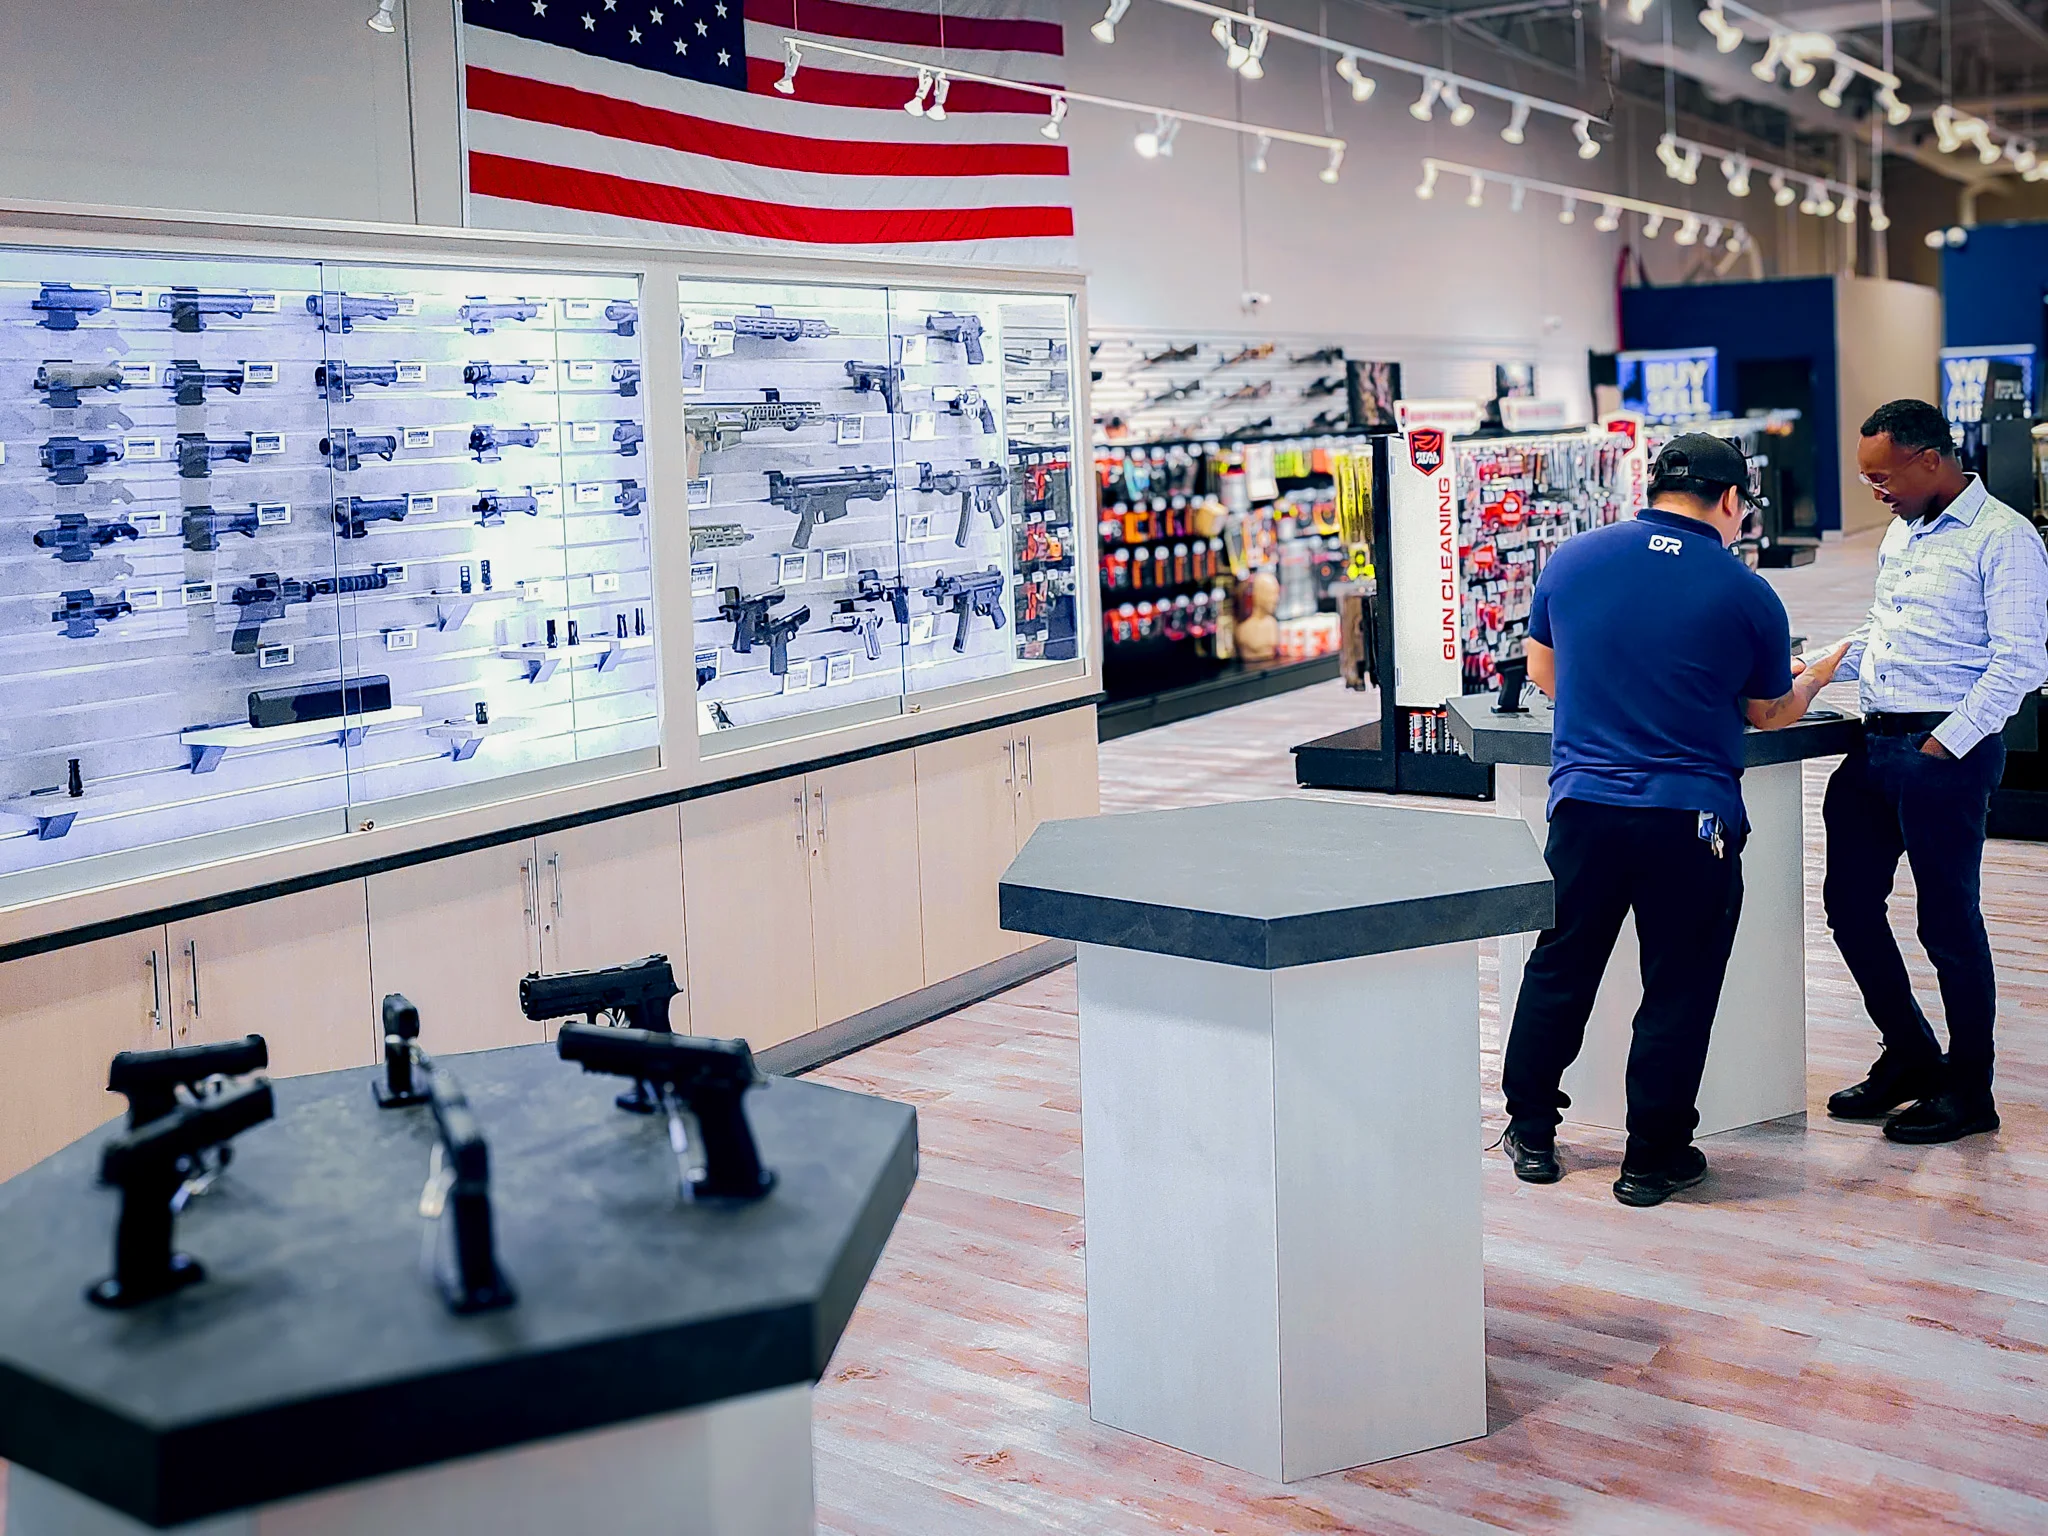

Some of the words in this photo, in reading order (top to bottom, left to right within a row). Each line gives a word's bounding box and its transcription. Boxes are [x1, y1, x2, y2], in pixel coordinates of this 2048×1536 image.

[1646, 361, 1709, 388] BUY
[1647, 388, 1711, 415] SELL
[1438, 477, 1455, 600] CLEANING
[1442, 608, 1456, 660] GUN
